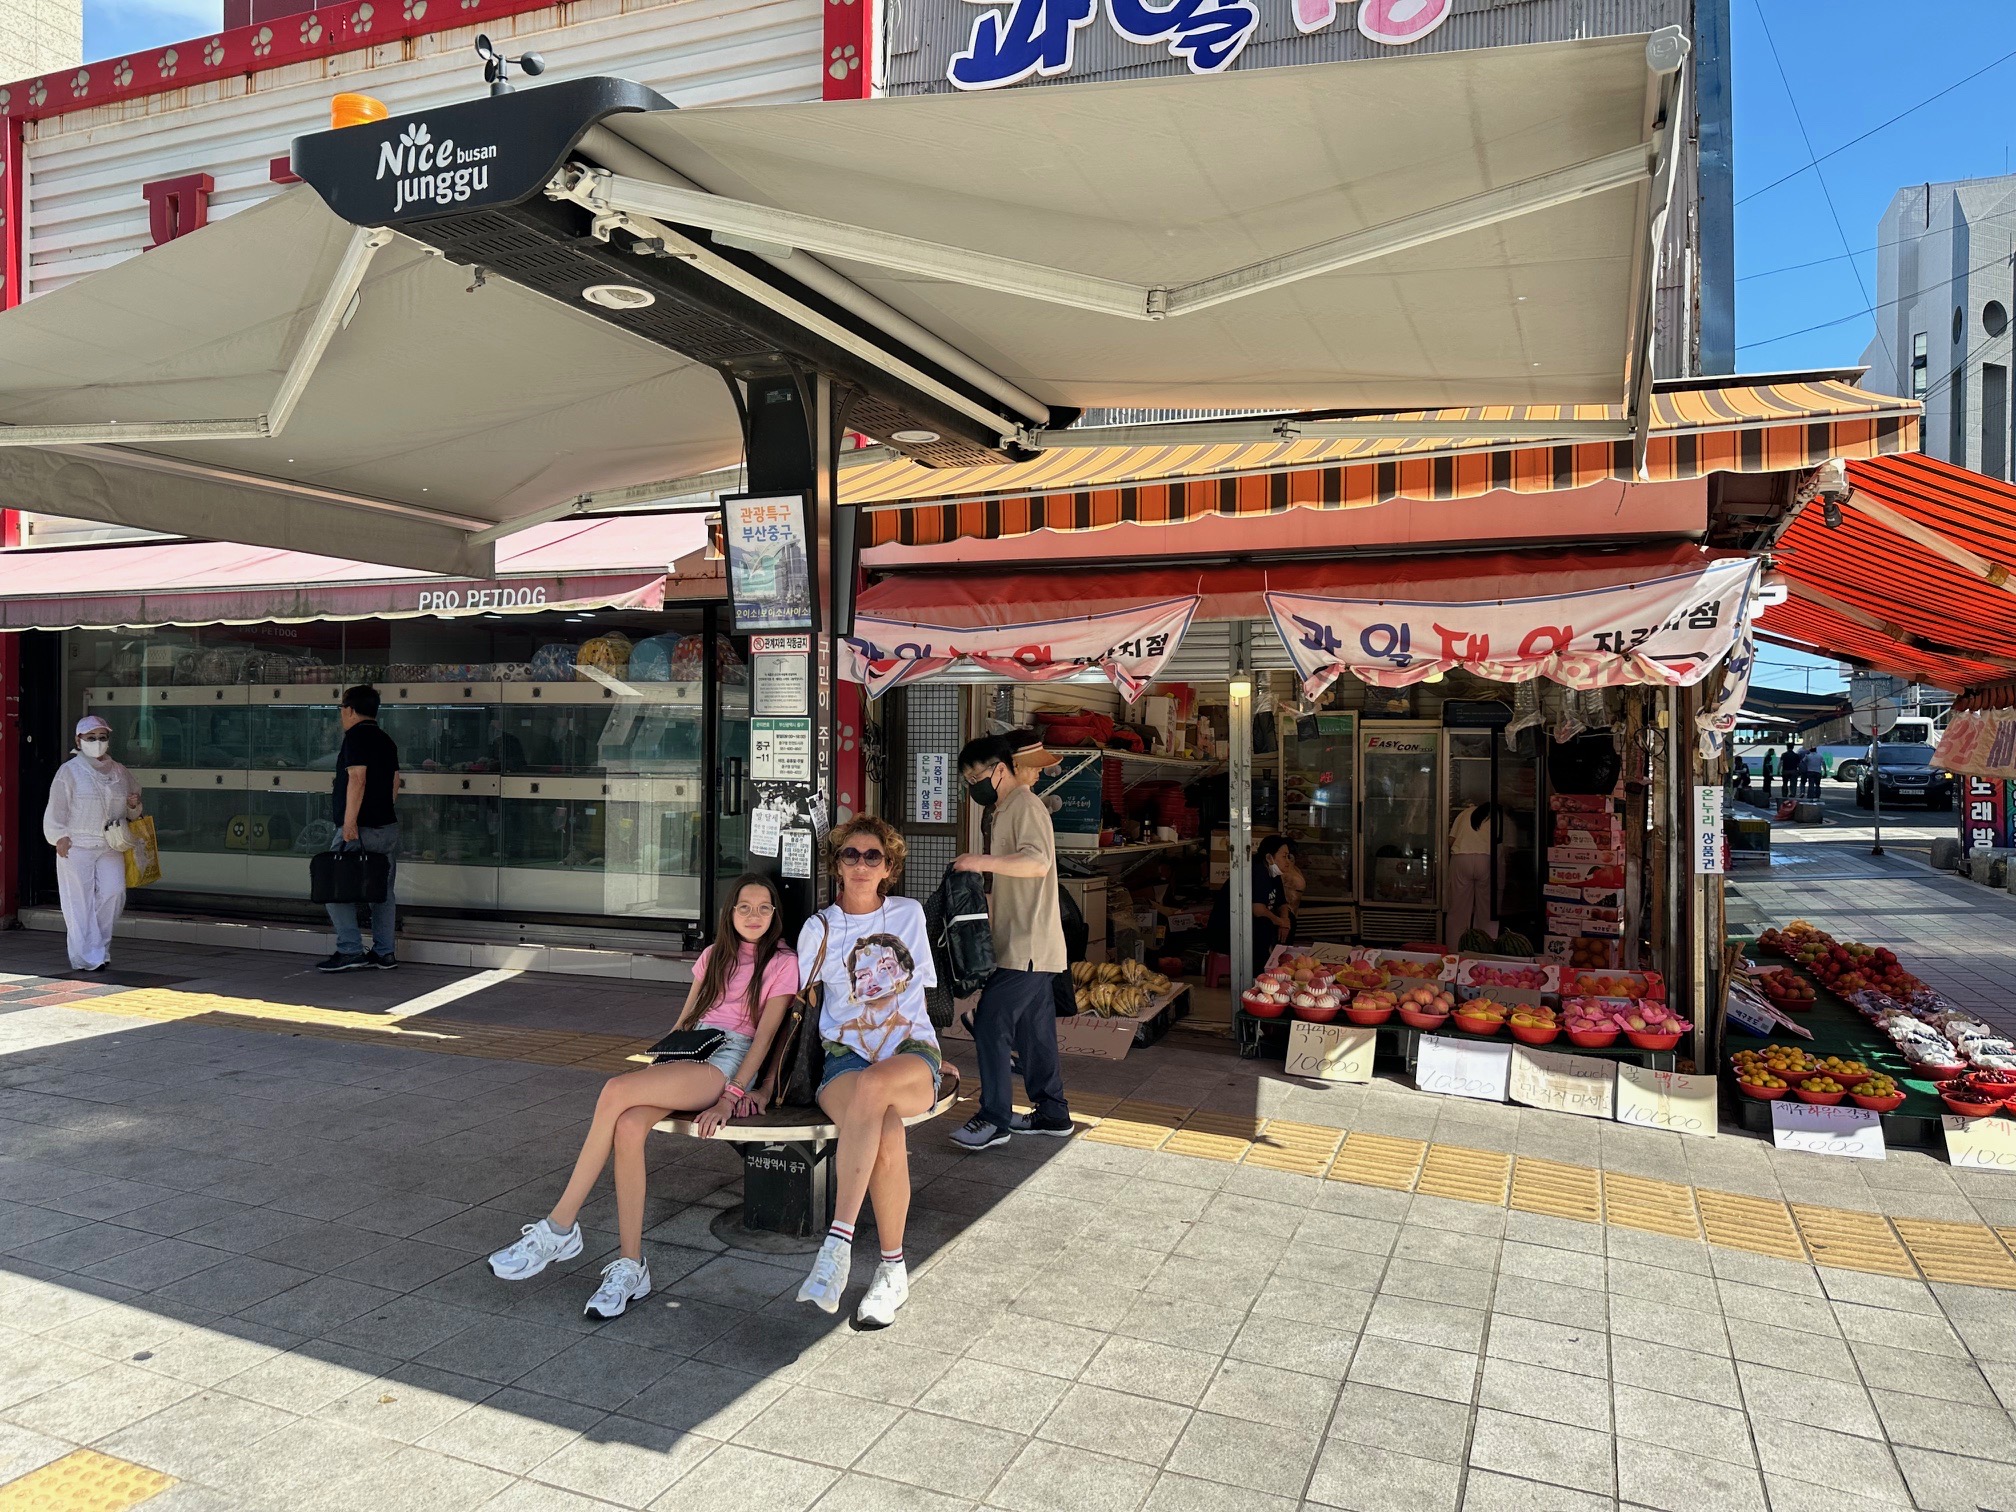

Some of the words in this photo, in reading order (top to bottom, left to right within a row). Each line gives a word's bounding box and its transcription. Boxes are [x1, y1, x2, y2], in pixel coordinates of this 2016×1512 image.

[376, 139, 454, 180] Nice
[456, 145, 497, 163] busan
[393, 165, 488, 213] junggu
[740, 505, 792, 524] 관광특구
[742, 525, 793, 542] 부산중구
[418, 590, 460, 611] PRO
[466, 586, 546, 609] PETDOG
[764, 637, 786, 649] 관계자외
[787, 637, 808, 649] 작동금지
[756, 741, 770, 751] 중구
[756, 753, 769, 762] -11
[921, 755, 931, 786] 온누리
[933, 755, 943, 795] 각종카드
[921, 790, 931, 820] 상품권
[933, 800, 943, 821] 환영
[1701, 788, 1715, 827] 온누리
[1971, 776, 1995, 848] 노래방
[1701, 832, 1715, 870] 상품권
[1289, 1053, 1359, 1074] 10000
[1423, 1071, 1495, 1094] 10000
[1655, 1071, 1693, 1090] 백도
[1624, 1104, 1702, 1130] 10000
[1777, 1102, 1803, 1116] 제주
[1807, 1105, 1847, 1118] 하우스
[1783, 1130, 1864, 1153] 5000
[747, 1155, 787, 1172] 부산광역시
[789, 1162, 806, 1174] 중구
